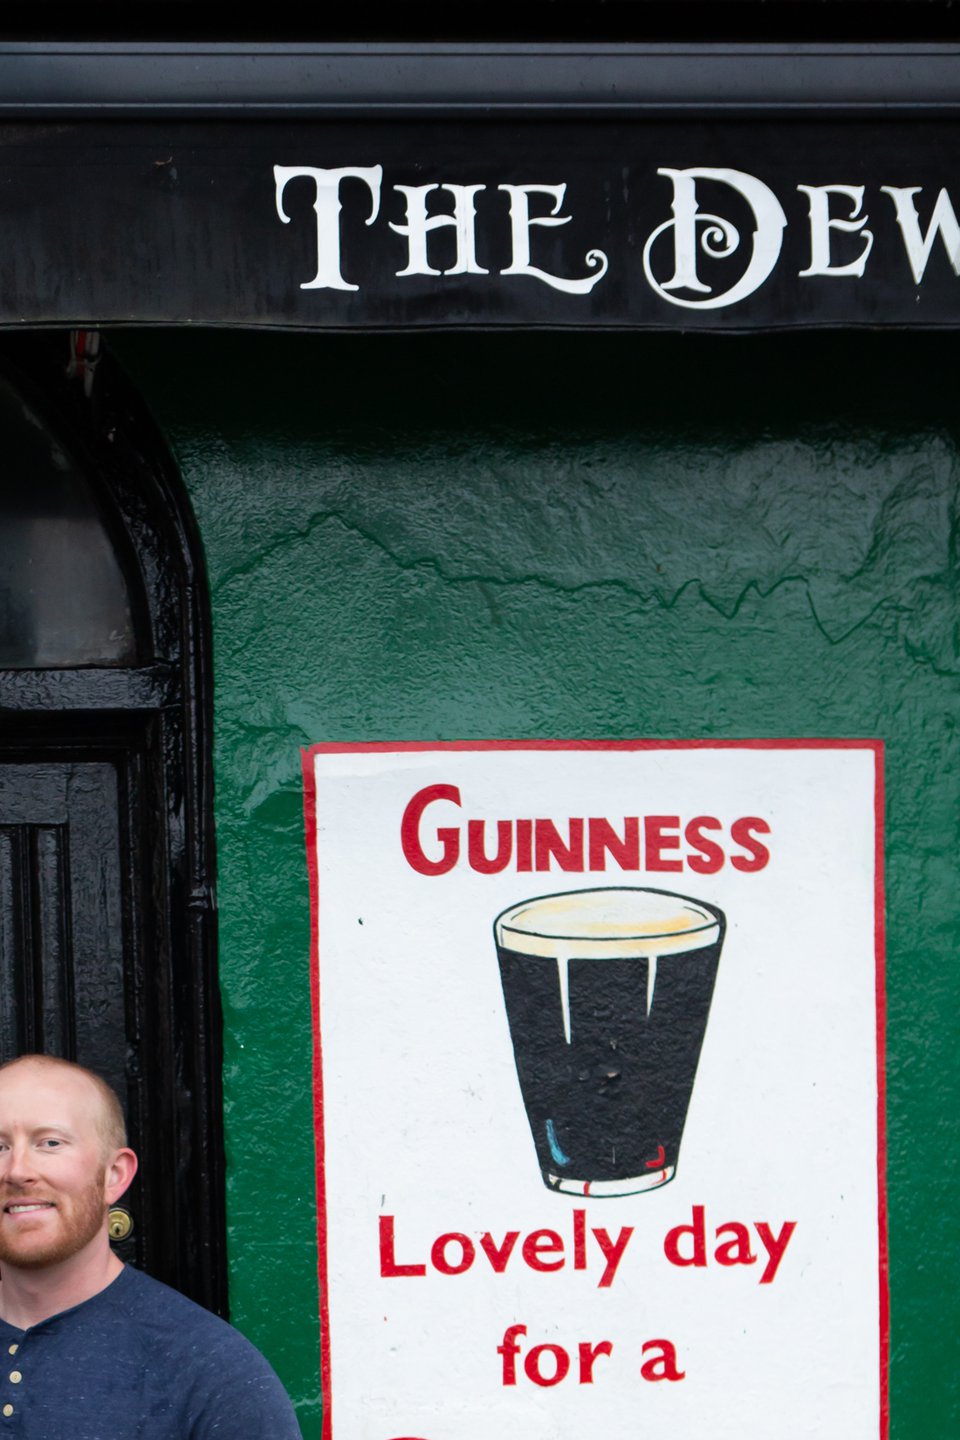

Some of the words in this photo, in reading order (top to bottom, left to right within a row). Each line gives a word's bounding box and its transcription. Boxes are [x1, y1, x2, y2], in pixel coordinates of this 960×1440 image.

[273, 164, 608, 295] THE
[400, 782, 771, 876] GUINNESS
[378, 1209, 634, 1287] Lovely
[663, 1205, 797, 1284] day
[497, 1324, 613, 1387] for
[640, 1337, 686, 1383] a
